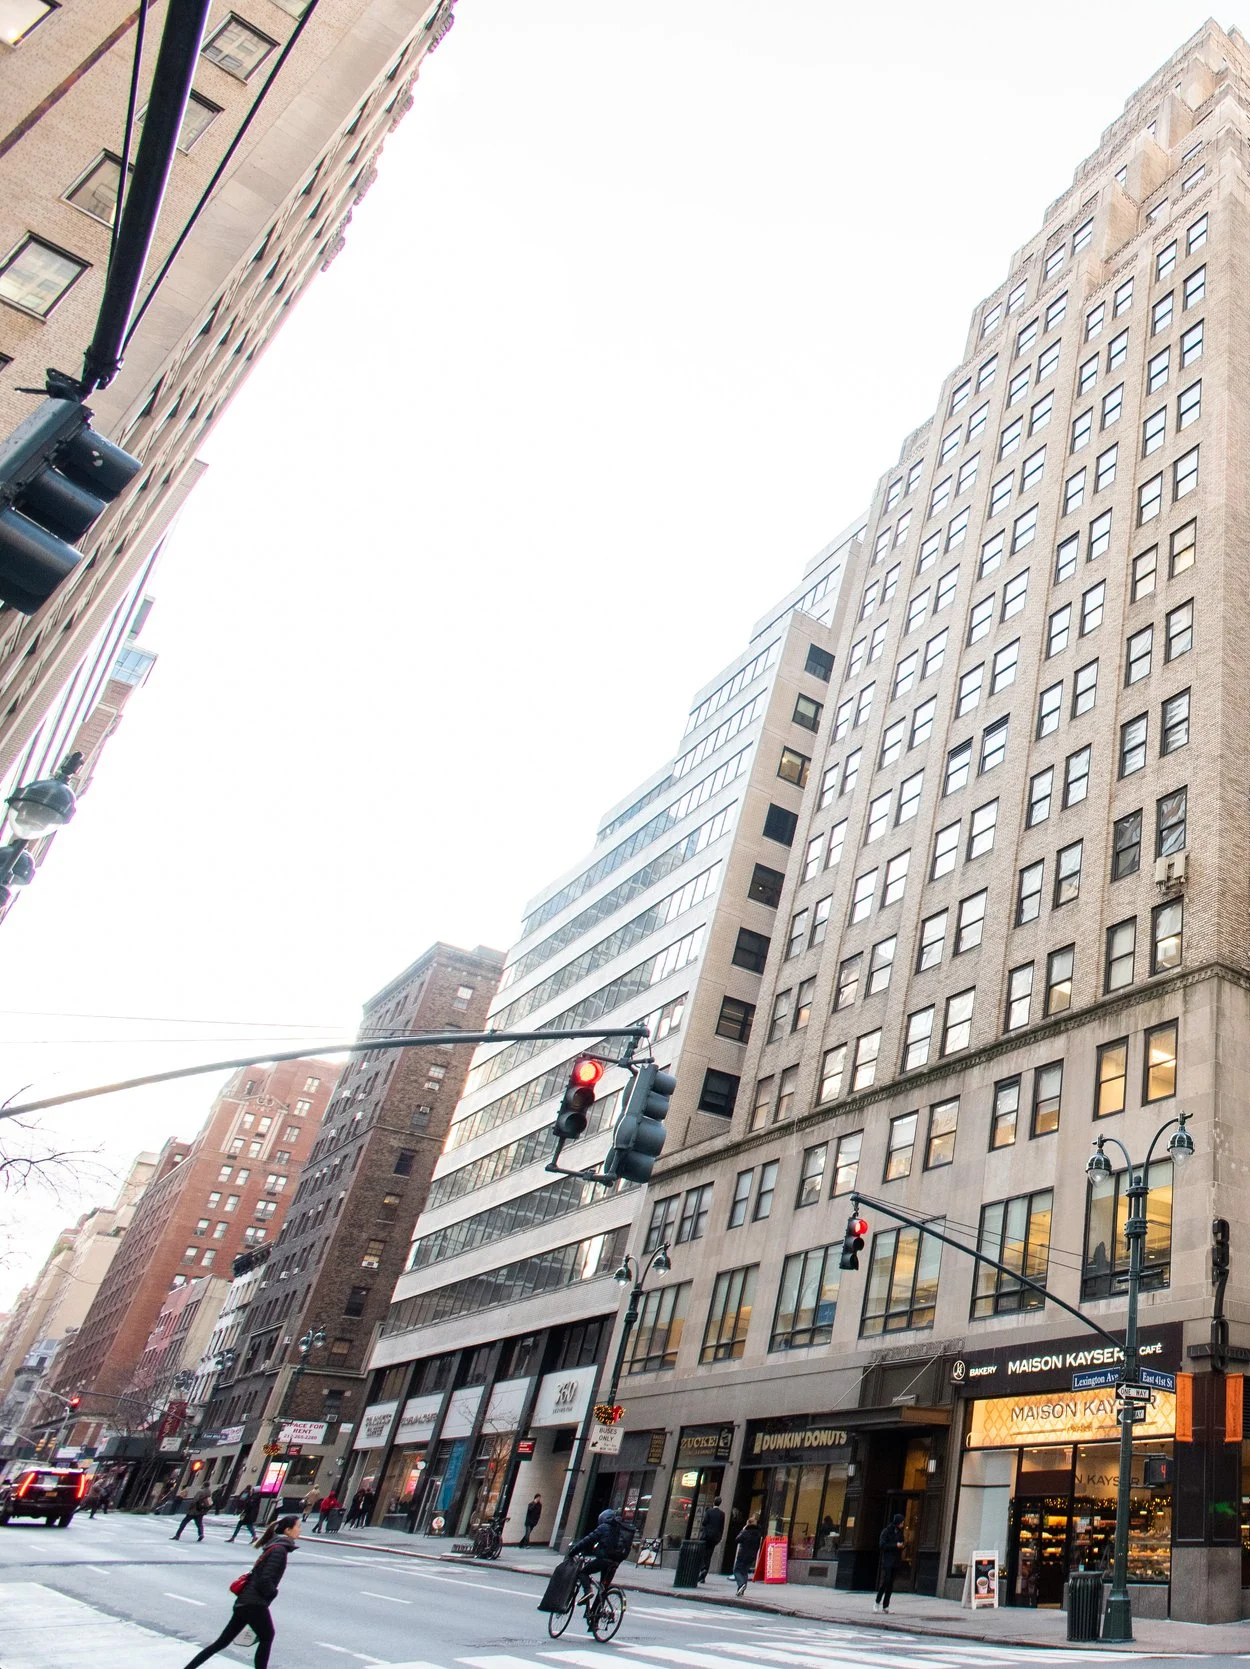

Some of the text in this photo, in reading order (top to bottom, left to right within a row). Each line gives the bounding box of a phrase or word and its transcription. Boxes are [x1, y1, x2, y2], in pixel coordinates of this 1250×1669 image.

[970, 1343, 1162, 1377] BAKERY MAISON KAYSER CAFÉ
[1074, 1376, 1105, 1387] Lexington
[1142, 1372, 1172, 1388] East 41st St
[1011, 1394, 1158, 1422] MAISON KAYR
[680, 1436, 718, 1448] ZUCKE
[764, 1430, 847, 1450] DUNKIN' DONUTS
[1087, 1476, 1139, 1486] KAYSR
